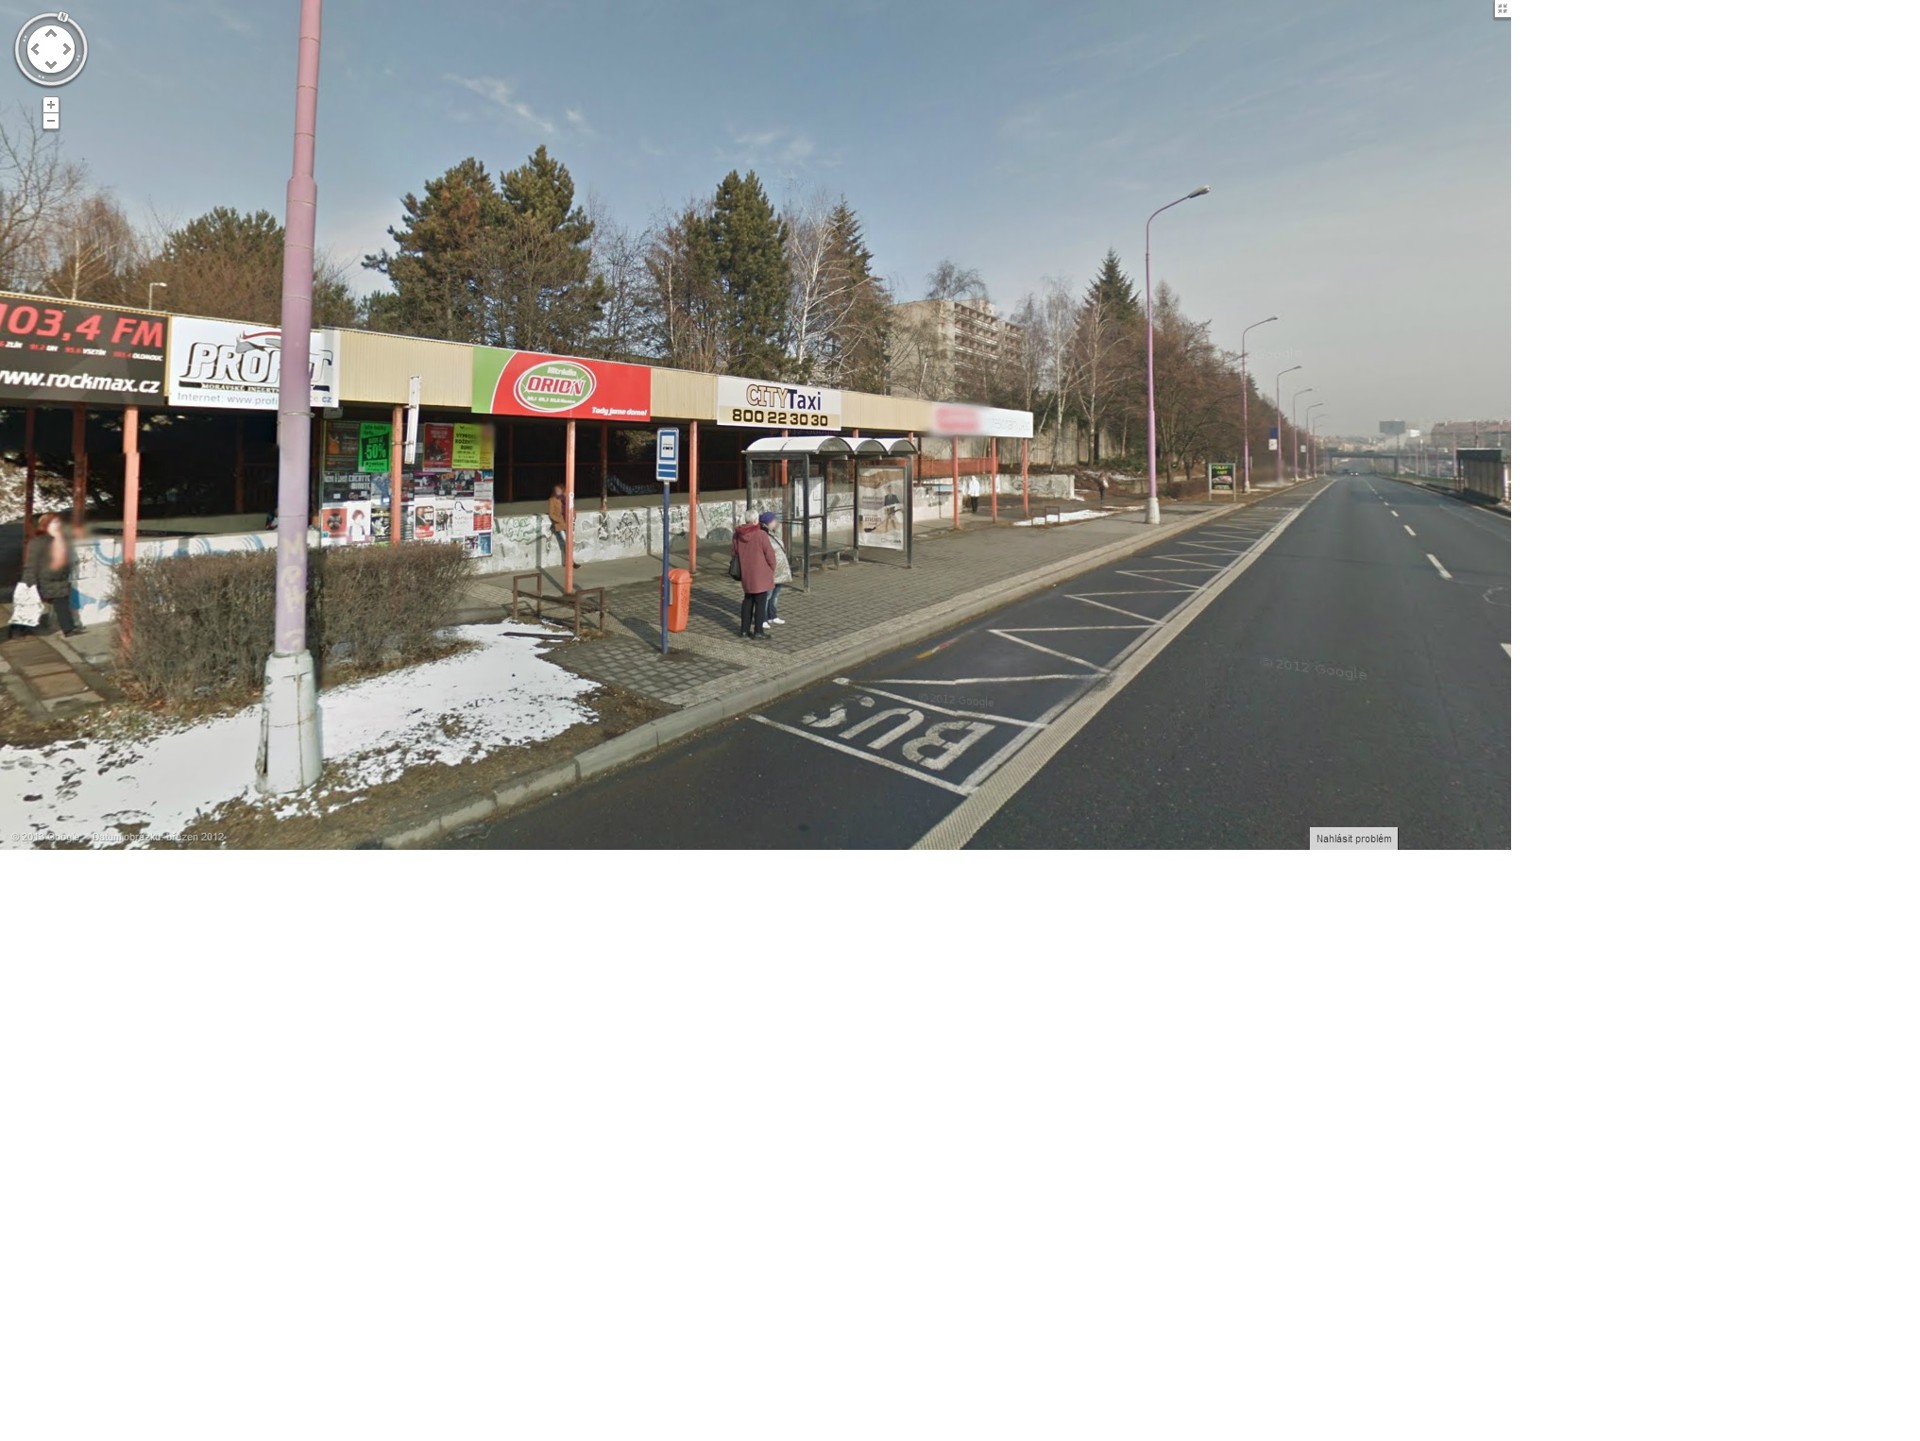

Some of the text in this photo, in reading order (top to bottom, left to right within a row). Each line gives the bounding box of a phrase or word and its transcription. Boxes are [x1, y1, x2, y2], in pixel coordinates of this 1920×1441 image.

[111, 317, 163, 348] FM
[0, 370, 161, 394] ww.rockmax.cz
[527, 375, 585, 396] ORION
[177, 392, 225, 403] Internet:
[732, 409, 828, 426] 800 22 30 30
[800, 695, 998, 771] BUS
